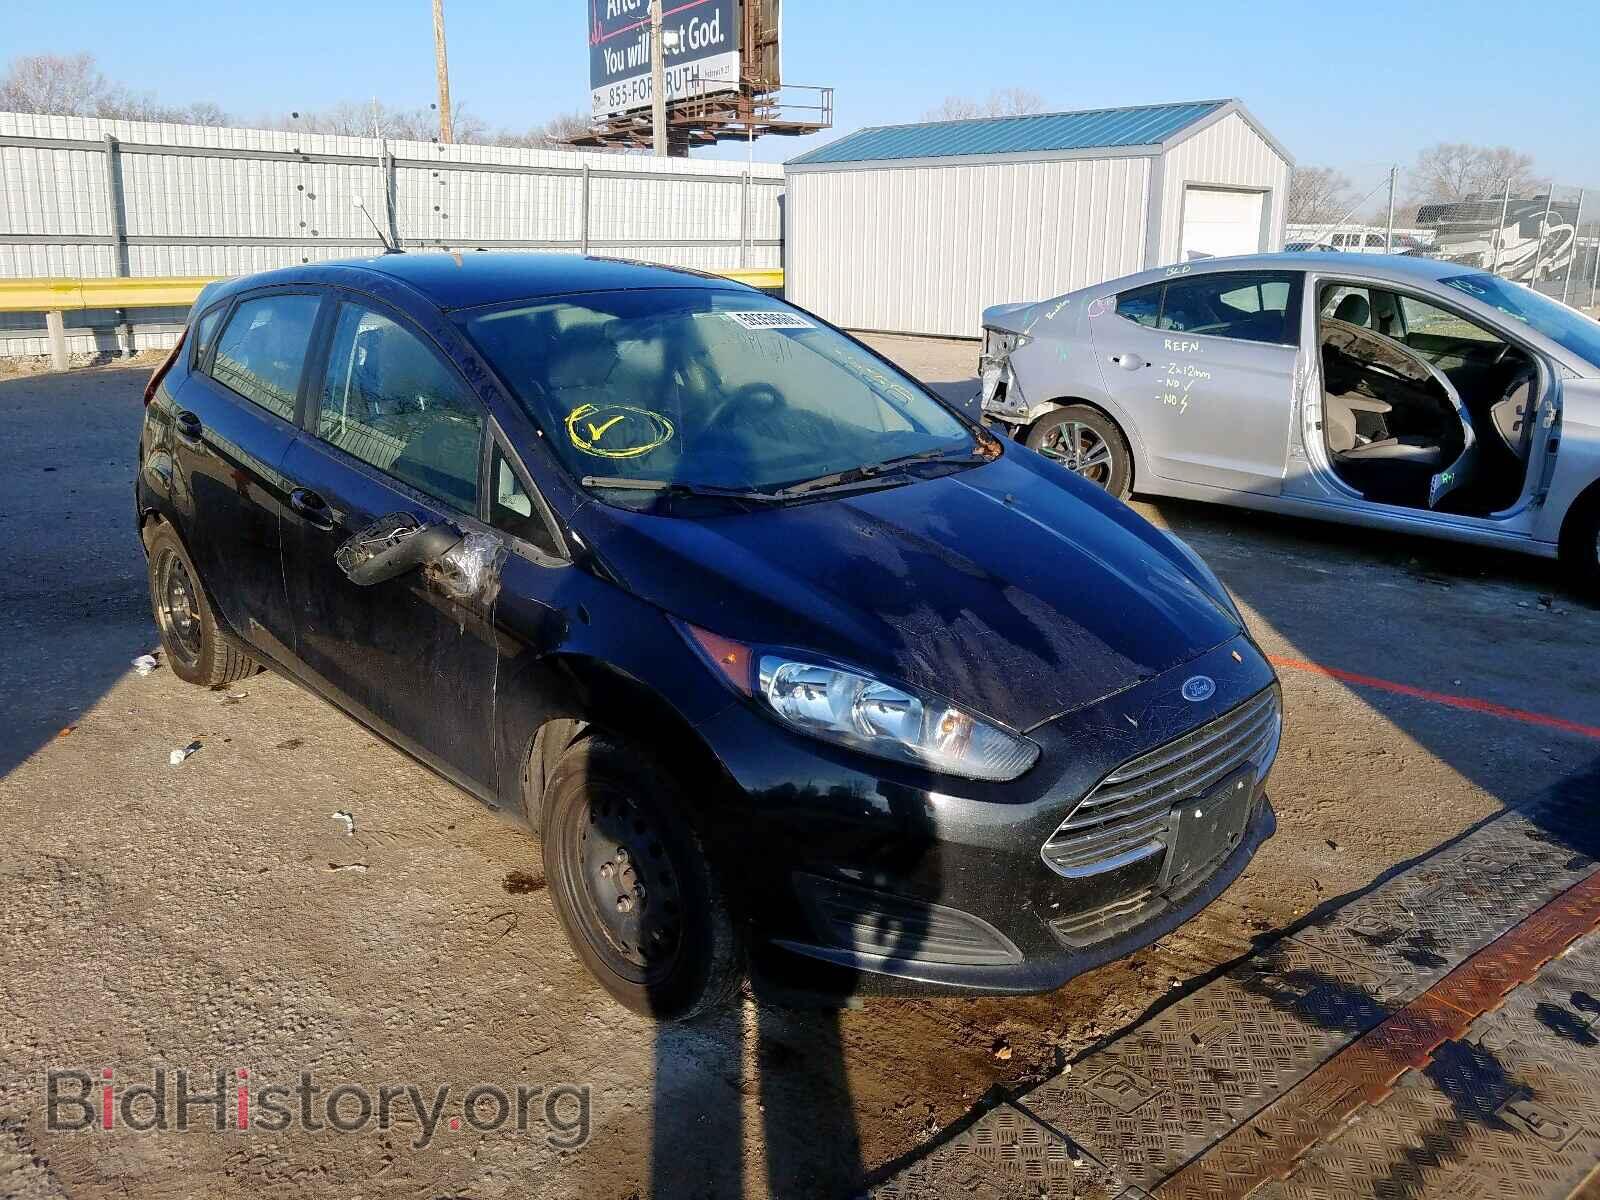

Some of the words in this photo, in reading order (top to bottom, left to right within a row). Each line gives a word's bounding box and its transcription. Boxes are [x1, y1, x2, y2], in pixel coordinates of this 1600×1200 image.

[603, 47, 624, 75] You
[628, 29, 650, 68] will
[688, 8, 725, 50] God.
